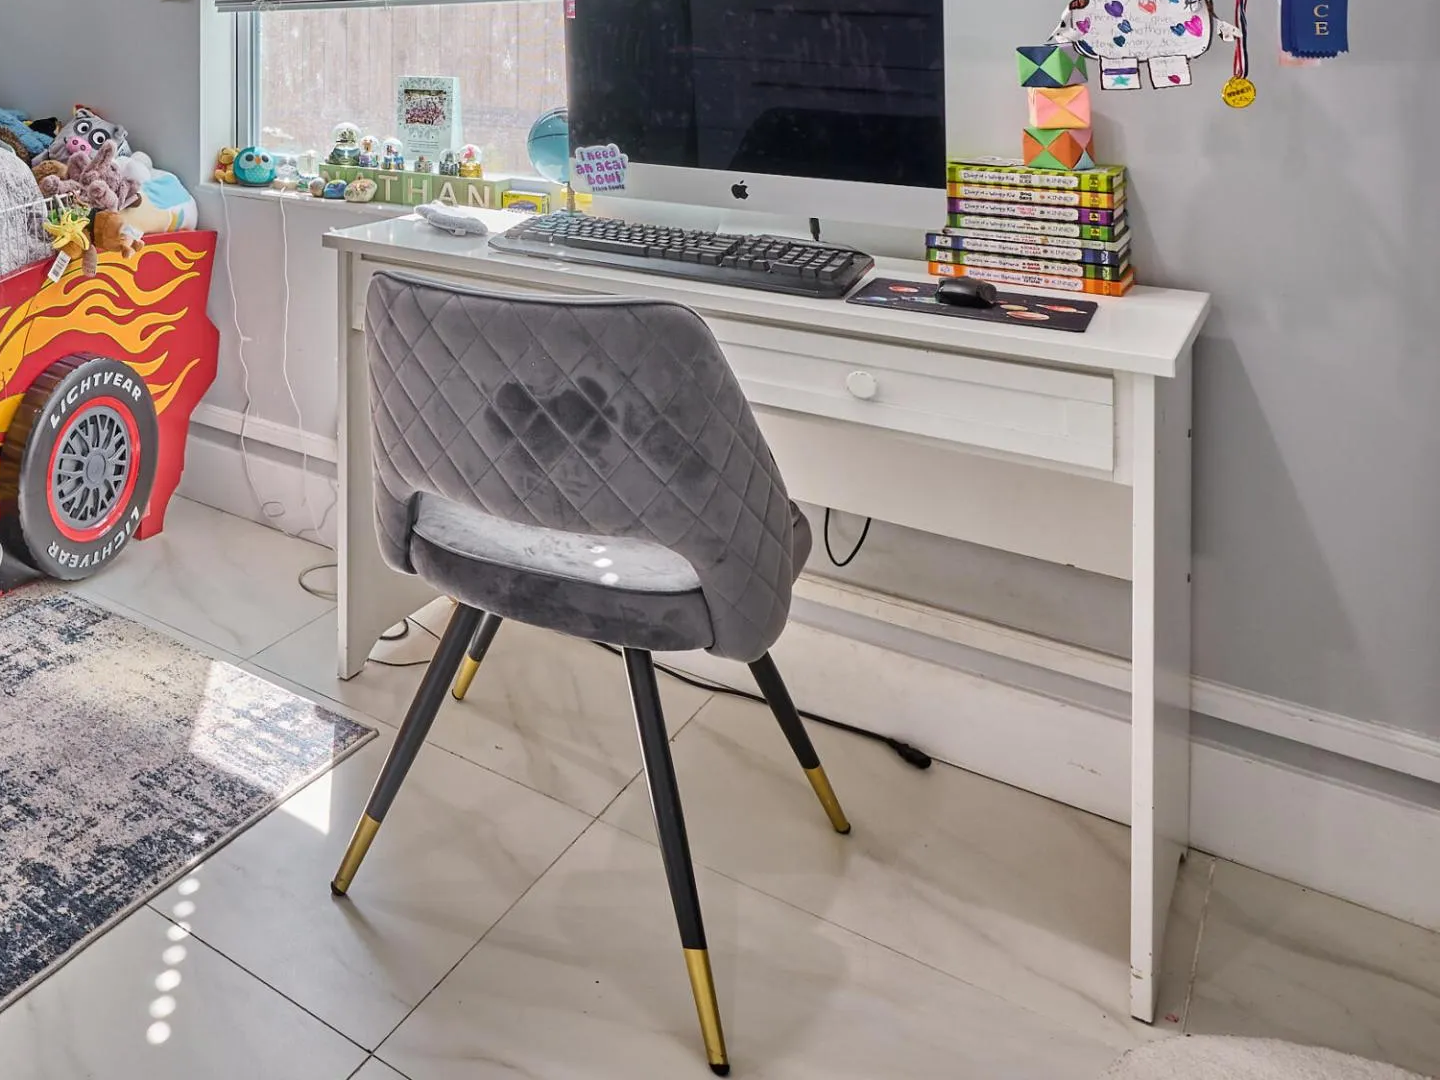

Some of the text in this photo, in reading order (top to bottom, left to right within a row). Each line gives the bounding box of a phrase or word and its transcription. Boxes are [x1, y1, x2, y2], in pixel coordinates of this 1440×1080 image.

[586, 148, 616, 161] need
[50, 371, 142, 429] LIGHTYEAR
[47, 506, 140, 569] LIGHTYEAR
